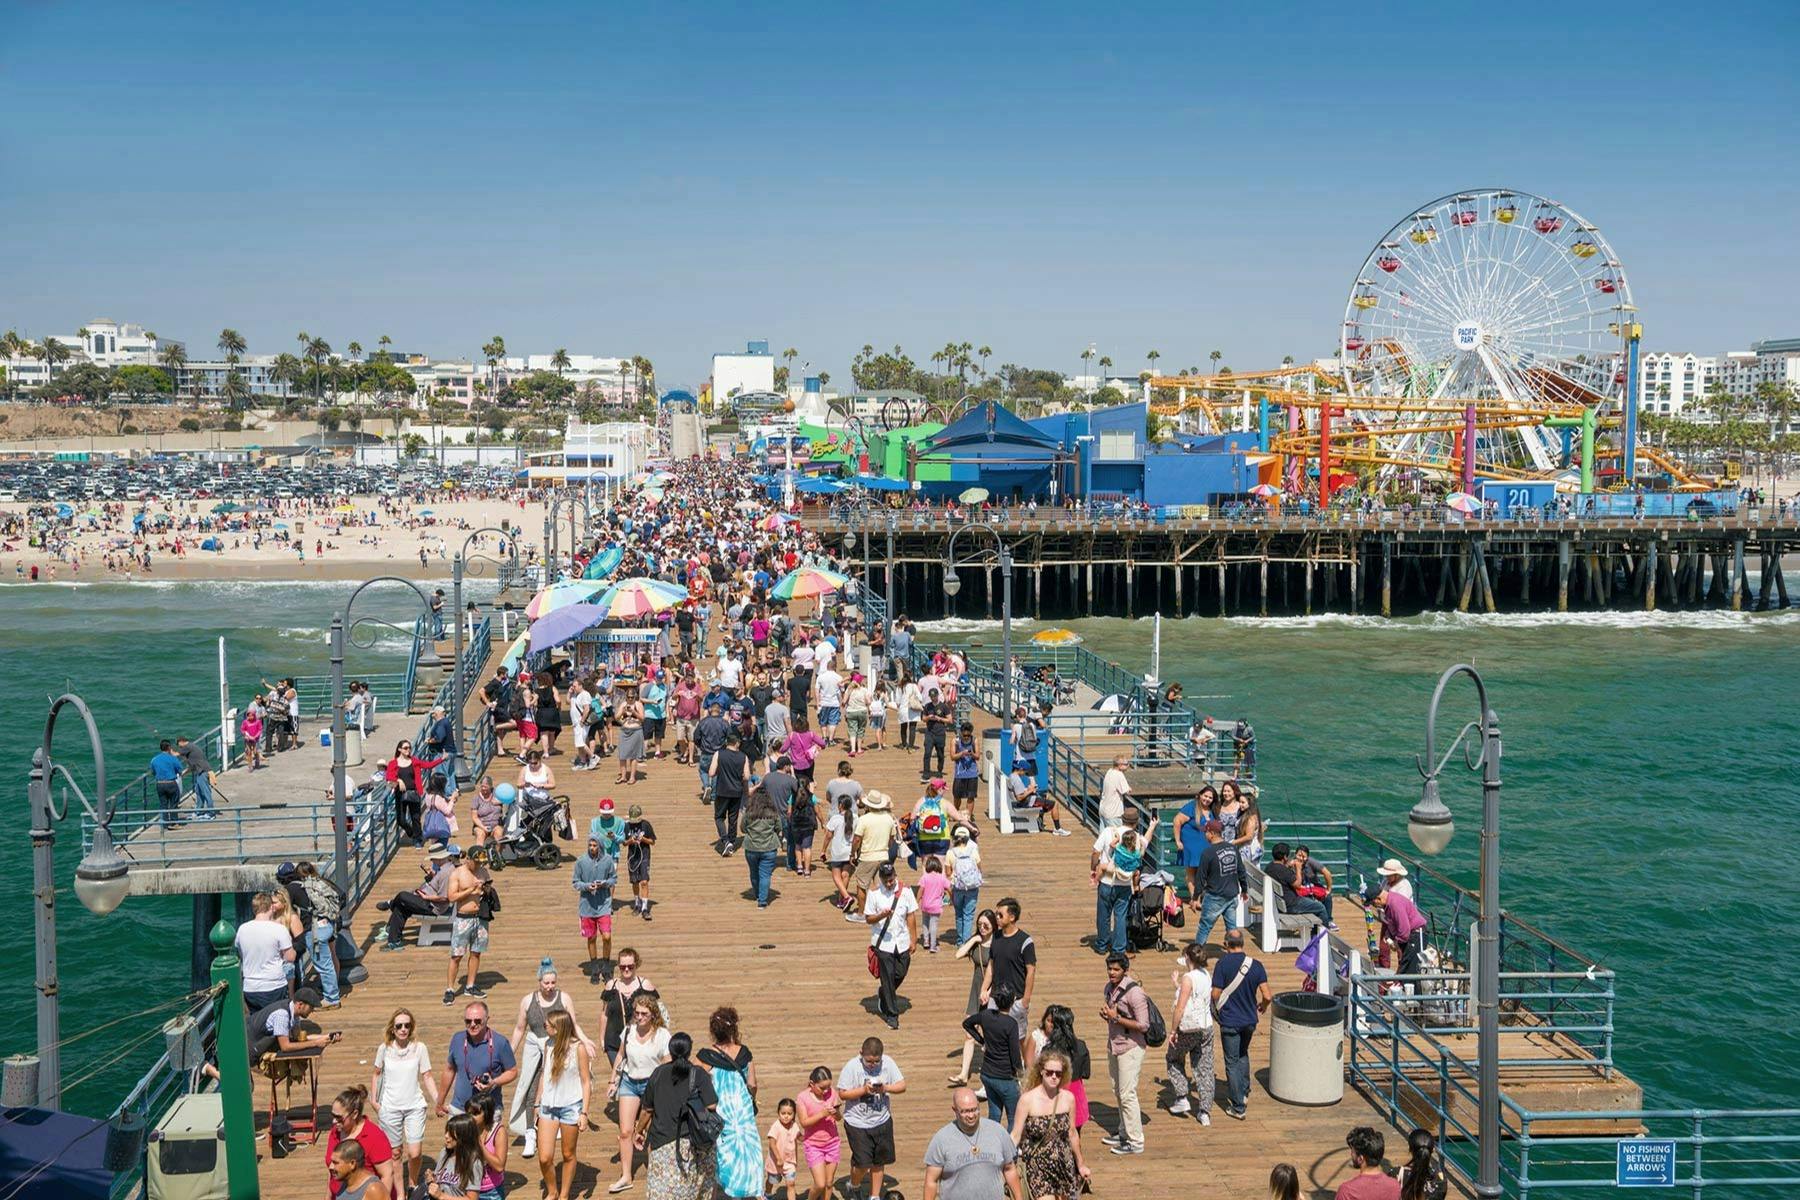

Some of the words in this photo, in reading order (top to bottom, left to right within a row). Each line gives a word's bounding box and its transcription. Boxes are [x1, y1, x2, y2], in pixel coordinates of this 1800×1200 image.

[1508, 489, 1529, 508] 20
[1623, 1145, 1636, 1153] NO
[1638, 1145, 1671, 1153] FISHING
[1626, 1154, 1667, 1162] BETWEEN
[1627, 1164, 1666, 1172] ARROWS
